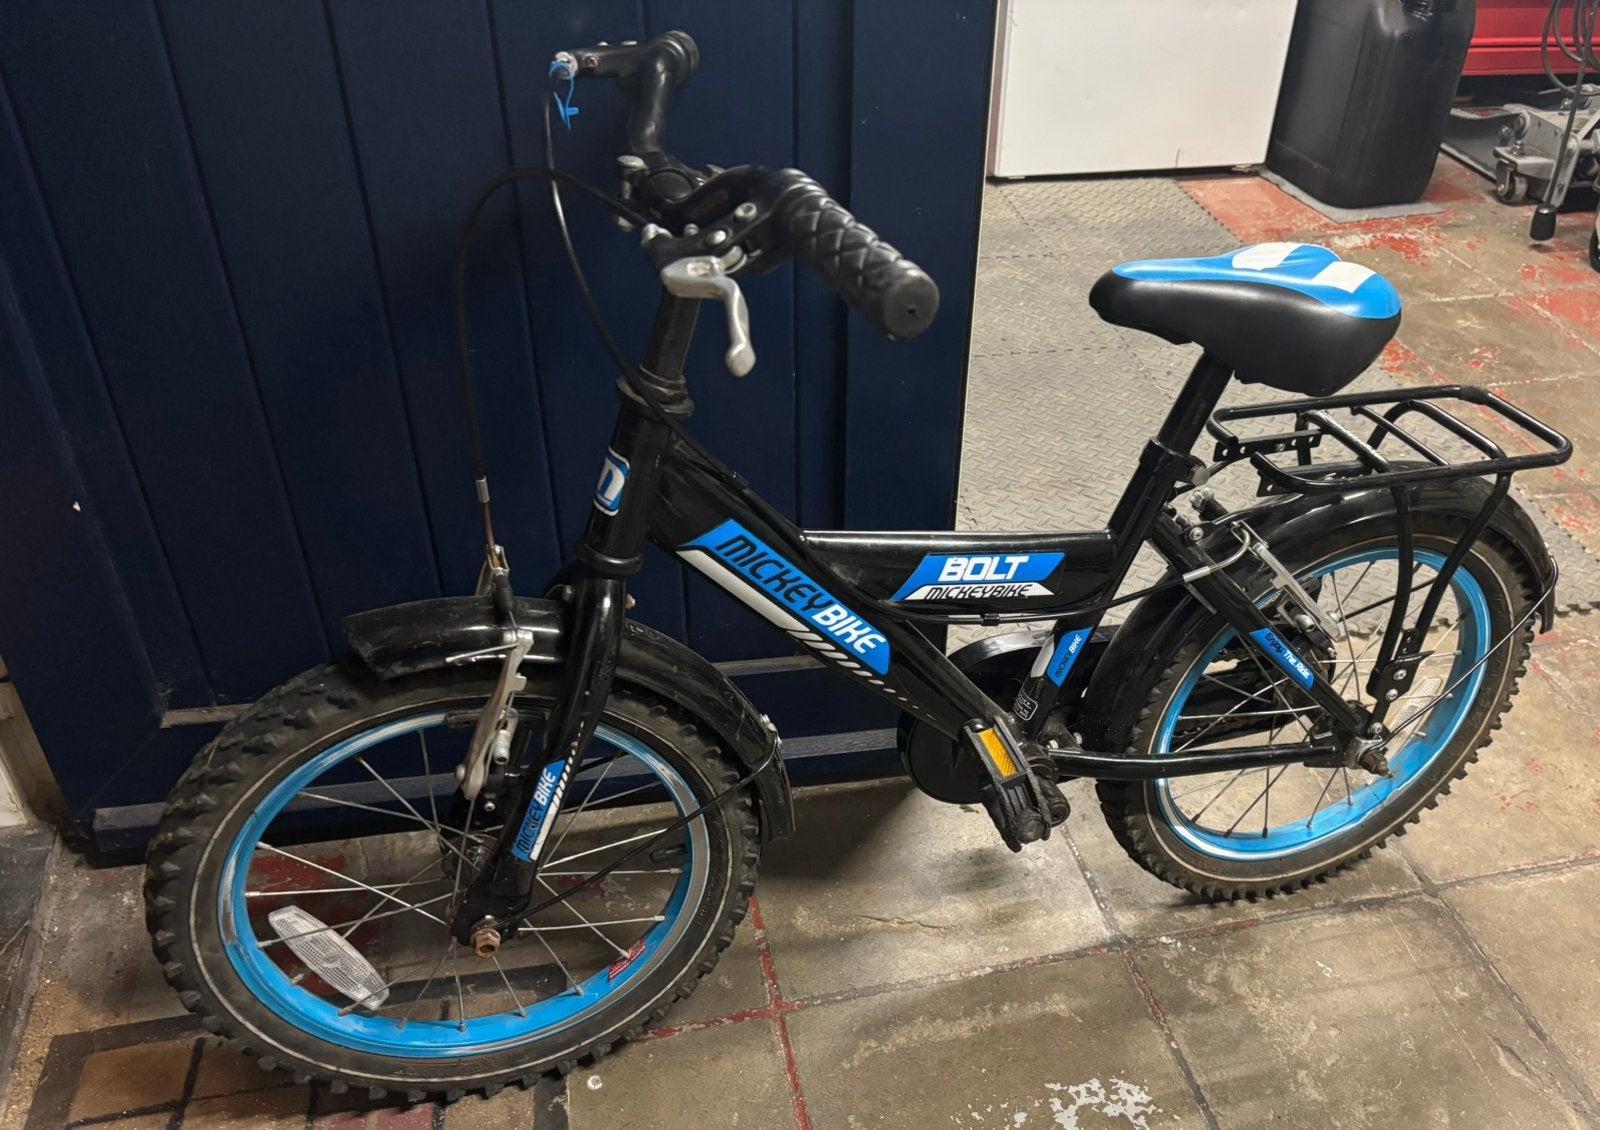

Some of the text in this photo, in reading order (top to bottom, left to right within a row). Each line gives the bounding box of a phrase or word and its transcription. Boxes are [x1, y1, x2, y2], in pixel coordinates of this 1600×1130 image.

[937, 555, 1030, 582] BOLT
[714, 534, 887, 654] MICKEYBIKE
[924, 584, 1033, 600] MICKEYBIKE
